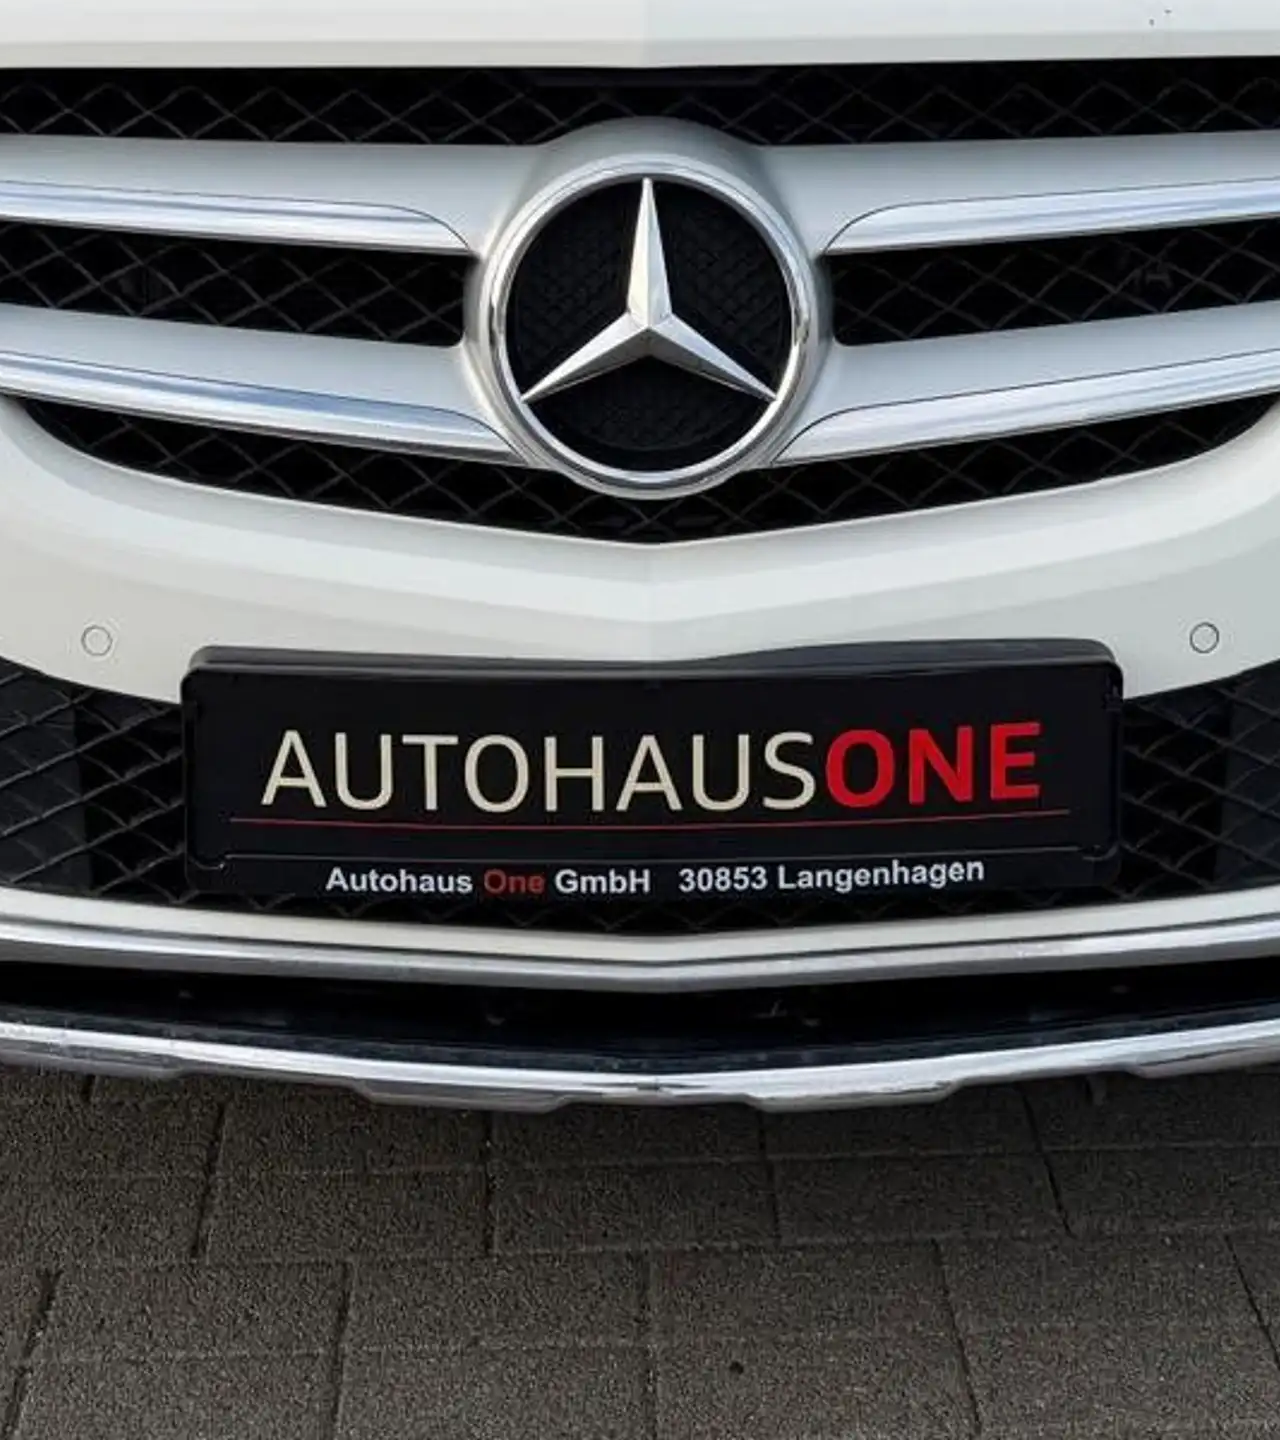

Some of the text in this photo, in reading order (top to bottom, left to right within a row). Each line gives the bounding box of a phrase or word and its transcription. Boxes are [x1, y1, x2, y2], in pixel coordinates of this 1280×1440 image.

[326, 860, 984, 894] Autohaus One GmbH 30853 Langenhagen
